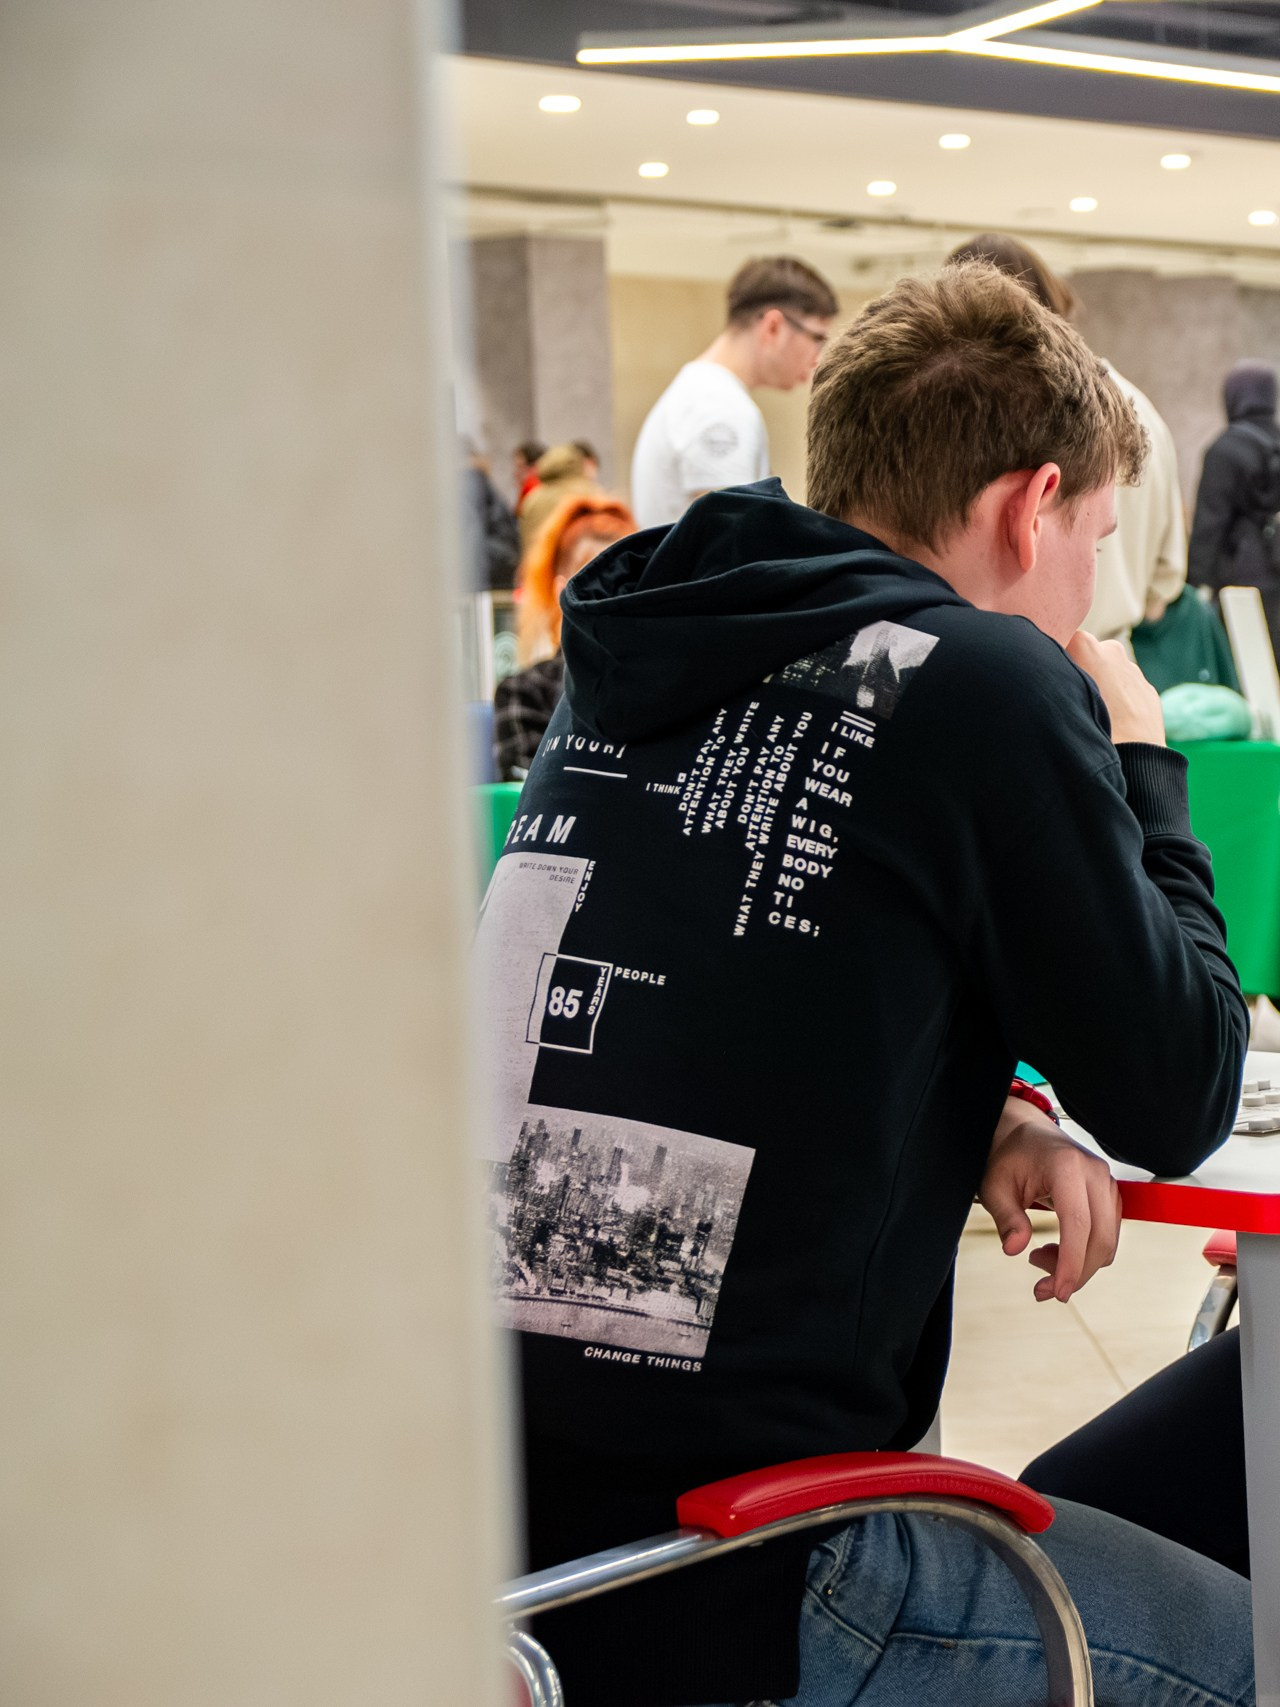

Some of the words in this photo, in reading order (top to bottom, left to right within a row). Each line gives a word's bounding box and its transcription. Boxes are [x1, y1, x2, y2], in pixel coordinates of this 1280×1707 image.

[830, 721, 838, 733] I
[840, 726, 875, 749] LIKE
[678, 768, 700, 811] DON'T
[696, 739, 714, 763] PAY
[712, 708, 727, 734] ANY
[821, 741, 847, 759] IF
[701, 792, 722, 834] WHAT
[717, 749, 738, 786] THEY
[733, 701, 760, 744] WRITE
[737, 779, 759, 824] DON'T
[753, 746, 771, 775] PAY
[766, 715, 785, 743] ANY
[812, 758, 850, 783] YOU
[646, 782, 651, 791] I
[653, 783, 682, 795] THINK
[683, 757, 716, 836] ATTENTION
[711, 735, 726, 751] TO
[715, 780, 738, 829] ABOUT
[731, 747, 750, 775] YOU
[745, 768, 776, 851] ATTENTION
[769, 745, 785, 763] TO
[804, 776, 853, 808] WEAR
[795, 797, 808, 811] A
[733, 894, 753, 937] WHAT
[745, 851, 766, 888] THEY
[758, 798, 779, 845] WRITE
[773, 743, 799, 793] ABOUT
[792, 711, 813, 739] YOU
[791, 814, 839, 843] WIG,
[786, 834, 838, 859] EVERY
[537, 863, 557, 872] DOWN
[559, 867, 579, 875] YOUR
[549, 874, 576, 884] DESIRE
[782, 853, 834, 878] BODY
[575, 860, 596, 912] ENJOY
[777, 873, 804, 891] NO
[773, 891, 794, 908] TI
[768, 911, 820, 937] CES;
[614, 966, 667, 986] PEOPLE
[548, 985, 584, 1019] 85
[587, 967, 608, 1016] YEARS
[584, 1346, 642, 1364] CHANGE
[646, 1355, 702, 1372] THINGS
